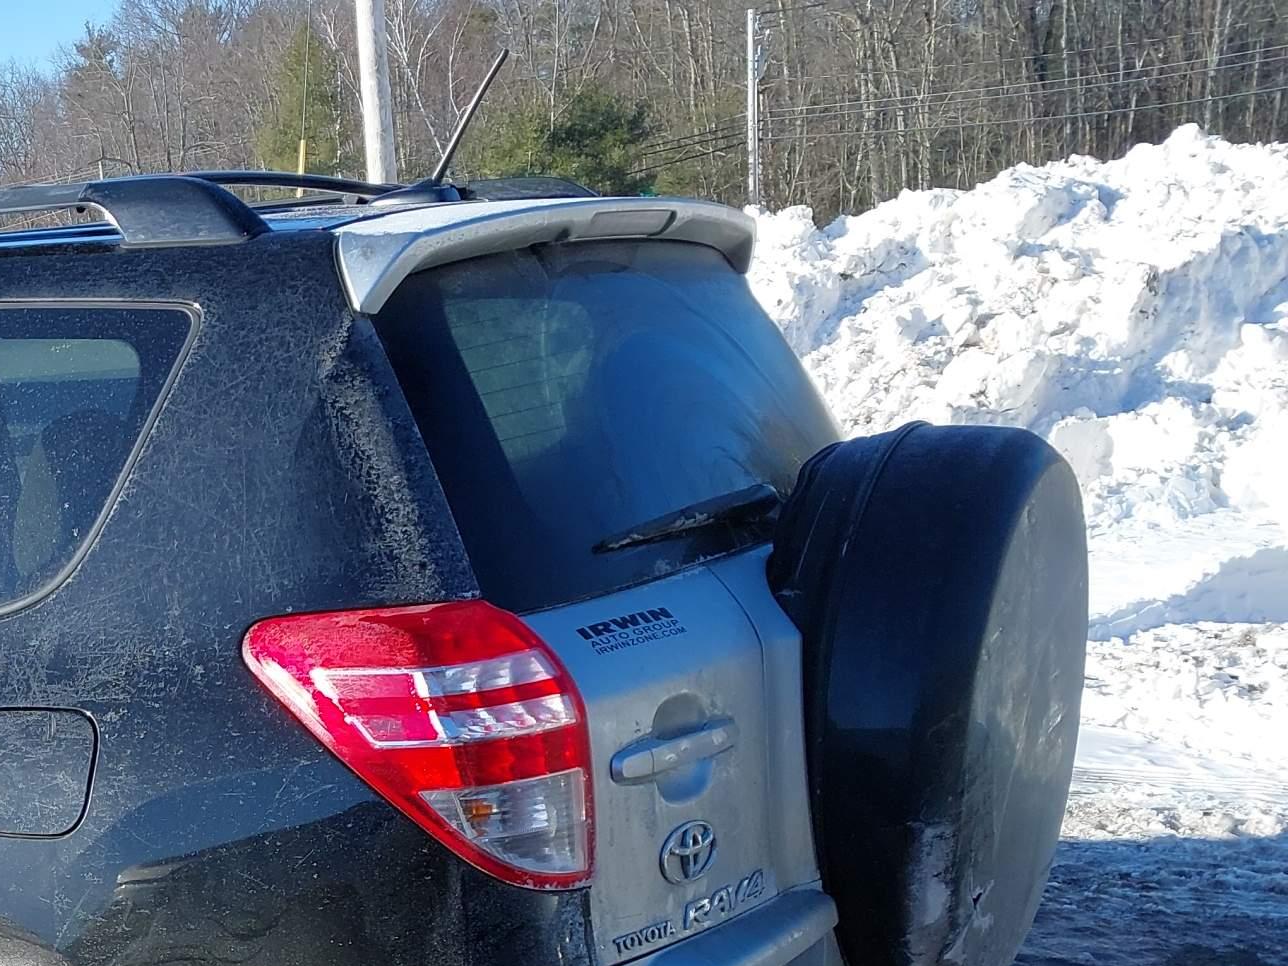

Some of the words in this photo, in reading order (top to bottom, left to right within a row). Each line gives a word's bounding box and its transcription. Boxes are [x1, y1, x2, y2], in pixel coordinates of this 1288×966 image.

[576, 607, 674, 641] IRWIN
[591, 631, 630, 649] AUTO
[633, 619, 680, 636] GROUP
[595, 626, 687, 656] IRWINZONE.COM
[613, 920, 676, 956] TOYOTA
[683, 868, 768, 931] RAV4
